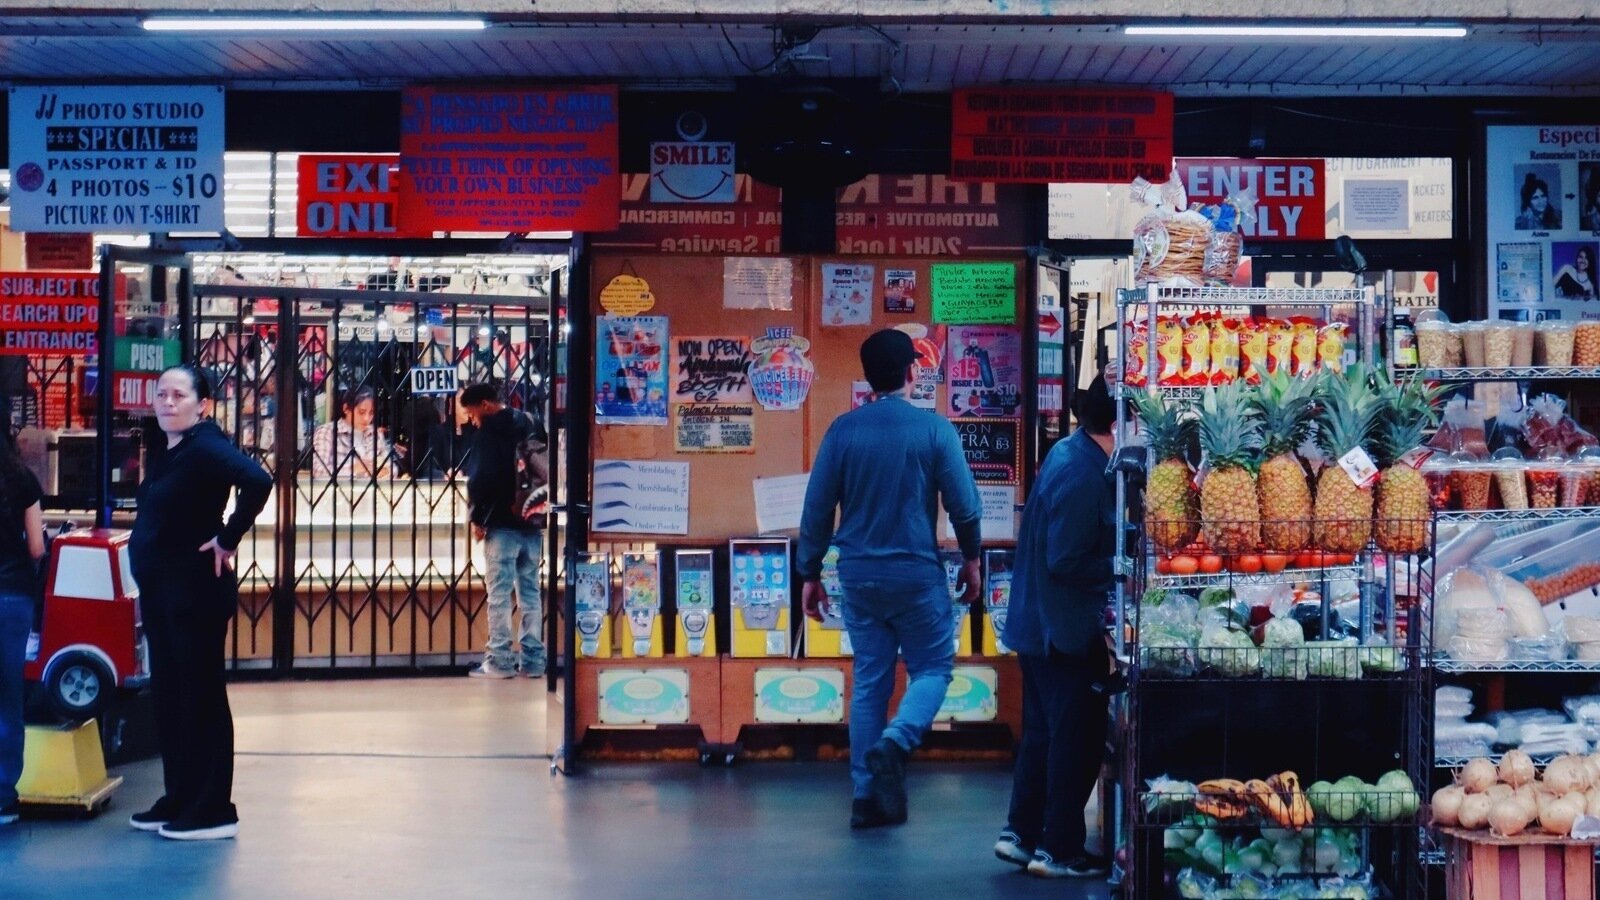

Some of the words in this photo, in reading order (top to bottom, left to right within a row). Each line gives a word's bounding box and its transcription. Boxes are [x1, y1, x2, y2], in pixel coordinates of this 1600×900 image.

[35, 94, 57, 120] JJ
[62, 103, 126, 120] PHOTO
[132, 102, 204, 119] STUDIO
[524, 94, 548, 113] EN
[78, 127, 165, 150] SPECIAL
[47, 157, 148, 170] PASSPORT
[155, 157, 167, 170] &
[175, 157, 197, 169] ID
[653, 146, 731, 166] SMILE
[1365, 157, 1422, 170] GARMENT
[457, 157, 507, 174] THINK
[513, 157, 536, 174] OF
[538, 157, 612, 175] OPENING
[46, 178, 57, 196] 4
[71, 179, 150, 197] PHOTOS
[172, 173, 217, 199] $10
[317, 162, 400, 193] EXI
[414, 177, 458, 194] YOUR
[463, 177, 503, 194] OWN
[1188, 166, 1315, 197] ENTER
[45, 205, 108, 225] PICTURE
[114, 205, 135, 225] ON
[140, 205, 201, 225] T-SHIRT
[1233, 206, 1304, 237] NLY
[1, 277, 76, 296] SUBJECT
[0, 304, 59, 322] EARCH
[5, 331, 96, 350] ENTRANCE
[769, 328, 792, 339] ICEE
[678, 340, 702, 356] NOW
[707, 338, 743, 356] OPEN
[130, 343, 164, 371] PUSH
[952, 358, 980, 378] $15
[415, 369, 454, 391] OPEN
[676, 376, 747, 394] BOOTH
[119, 378, 143, 404] EXIT
[694, 391, 719, 402] G2
[997, 384, 1017, 396] $10
[954, 423, 991, 434] VON
